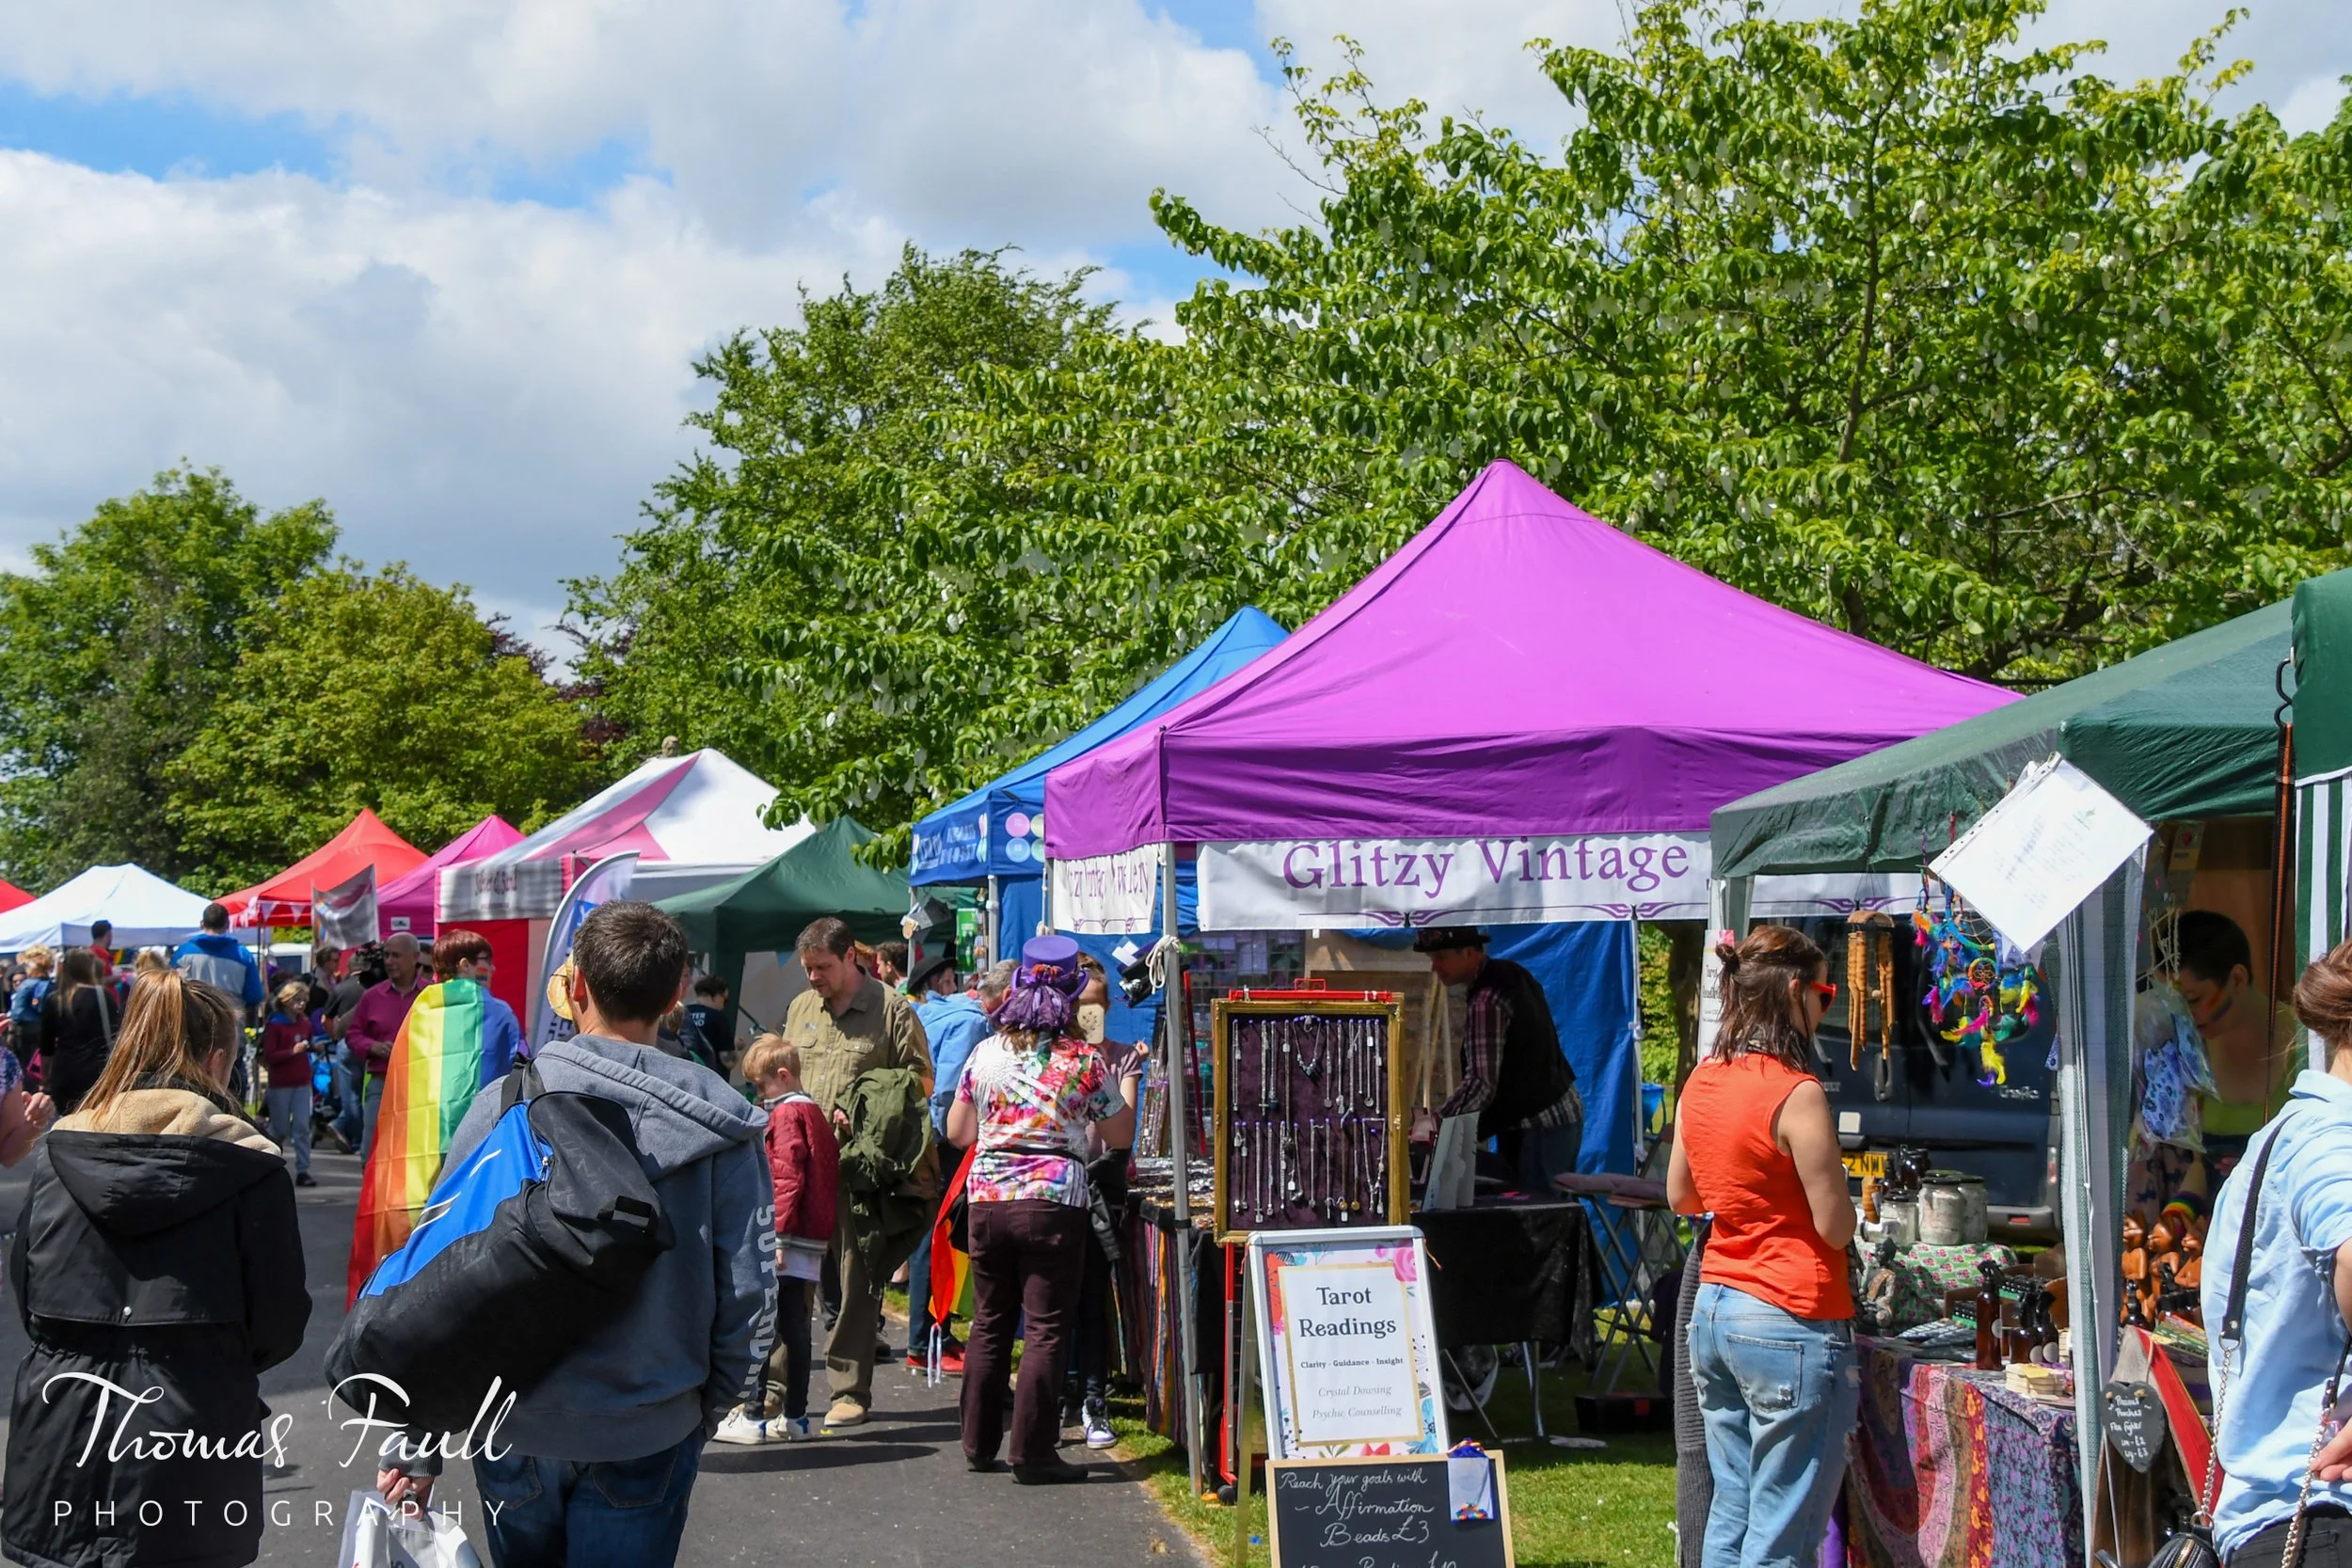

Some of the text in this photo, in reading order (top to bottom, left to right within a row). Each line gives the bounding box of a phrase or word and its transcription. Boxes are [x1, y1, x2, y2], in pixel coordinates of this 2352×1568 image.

[1283, 835, 1690, 899] Glitzy Vintage
[1315, 1287, 1373, 1306] Tarot
[1298, 1318, 1397, 1339] Readings
[1300, 1356, 1404, 1370] Clarity Guidance Insight
[1318, 1386, 1350, 1399] Crystal
[1311, 1405, 1403, 1420] Psychic Counselling
[1278, 1467, 1427, 1497] Reach your goals with
[1315, 1484, 1435, 1521] Affirmation
[1320, 1522, 1391, 1547] Beads
